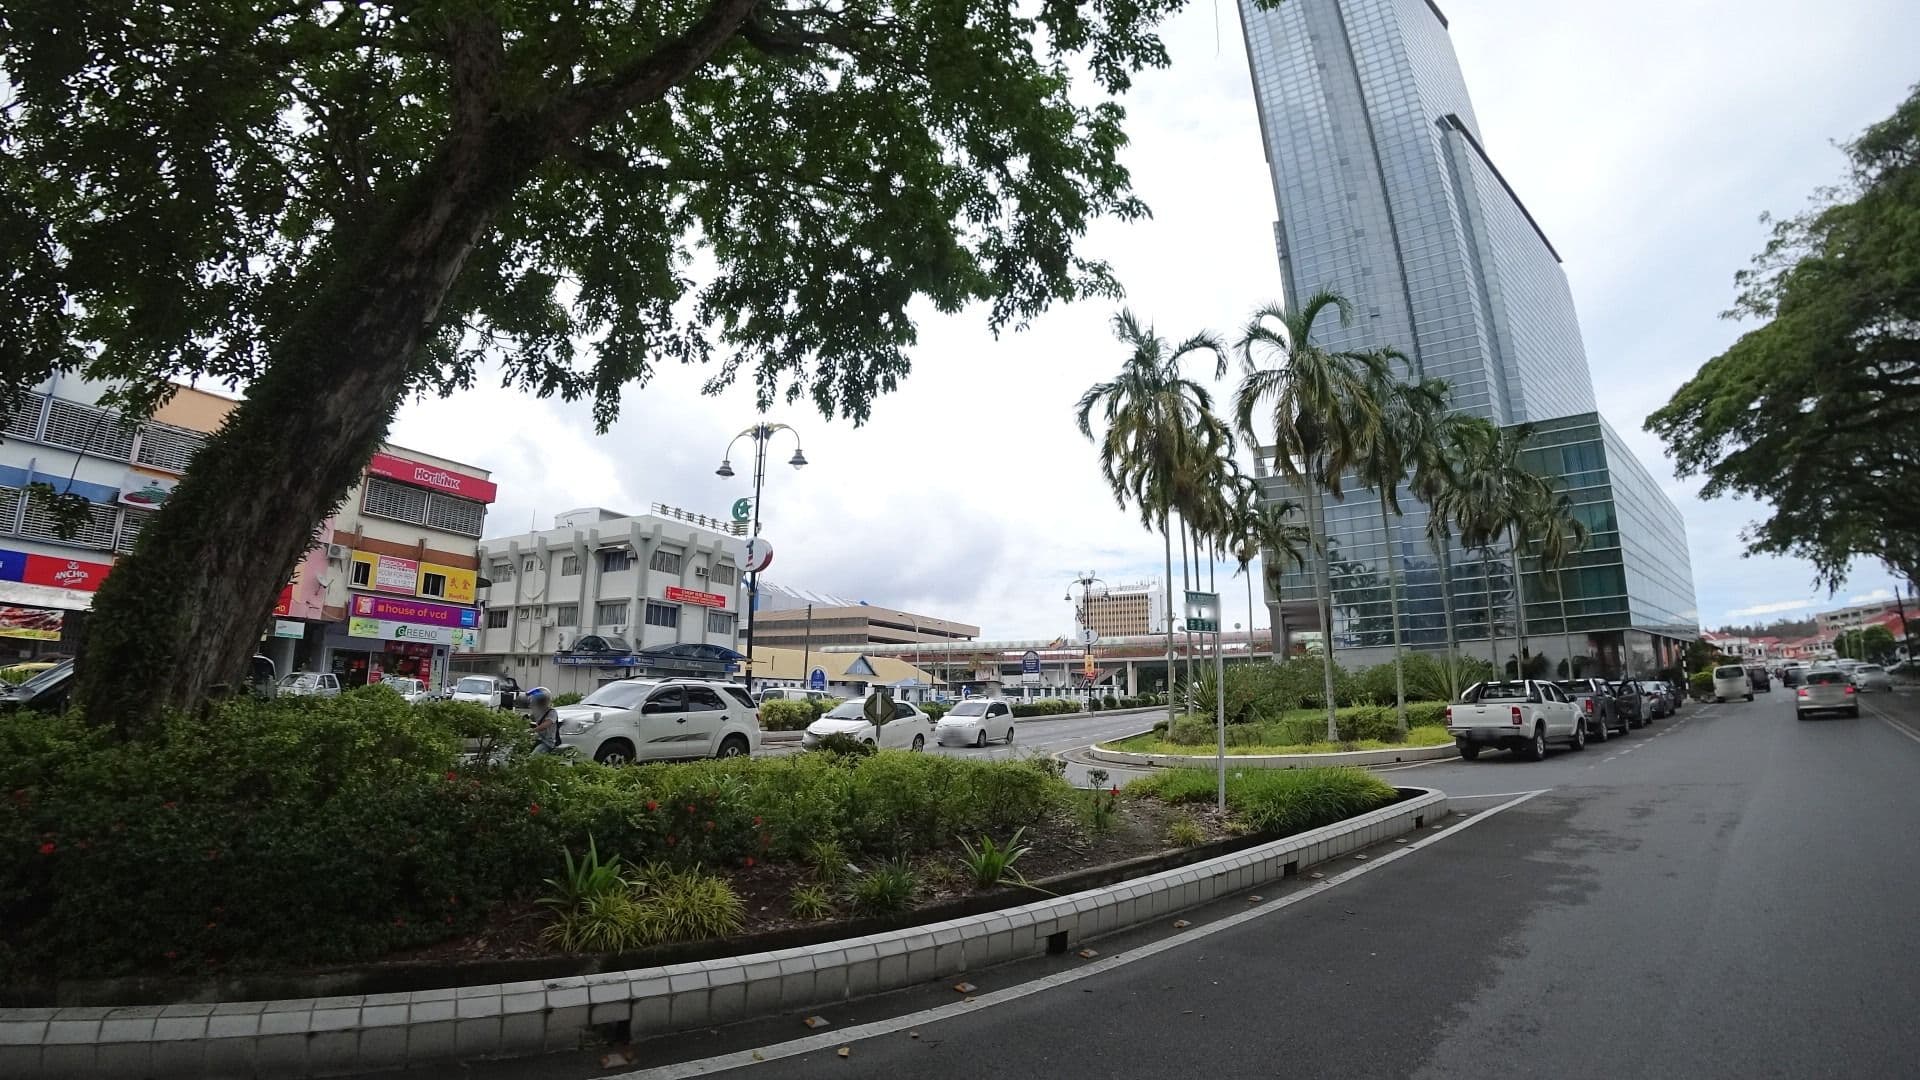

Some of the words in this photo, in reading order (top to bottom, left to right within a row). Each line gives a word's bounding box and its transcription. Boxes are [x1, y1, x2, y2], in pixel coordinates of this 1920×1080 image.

[385, 603, 416, 616] house
[417, 608, 428, 617] of
[429, 609, 448, 620] vcd
[395, 625, 437, 638] GREENO
